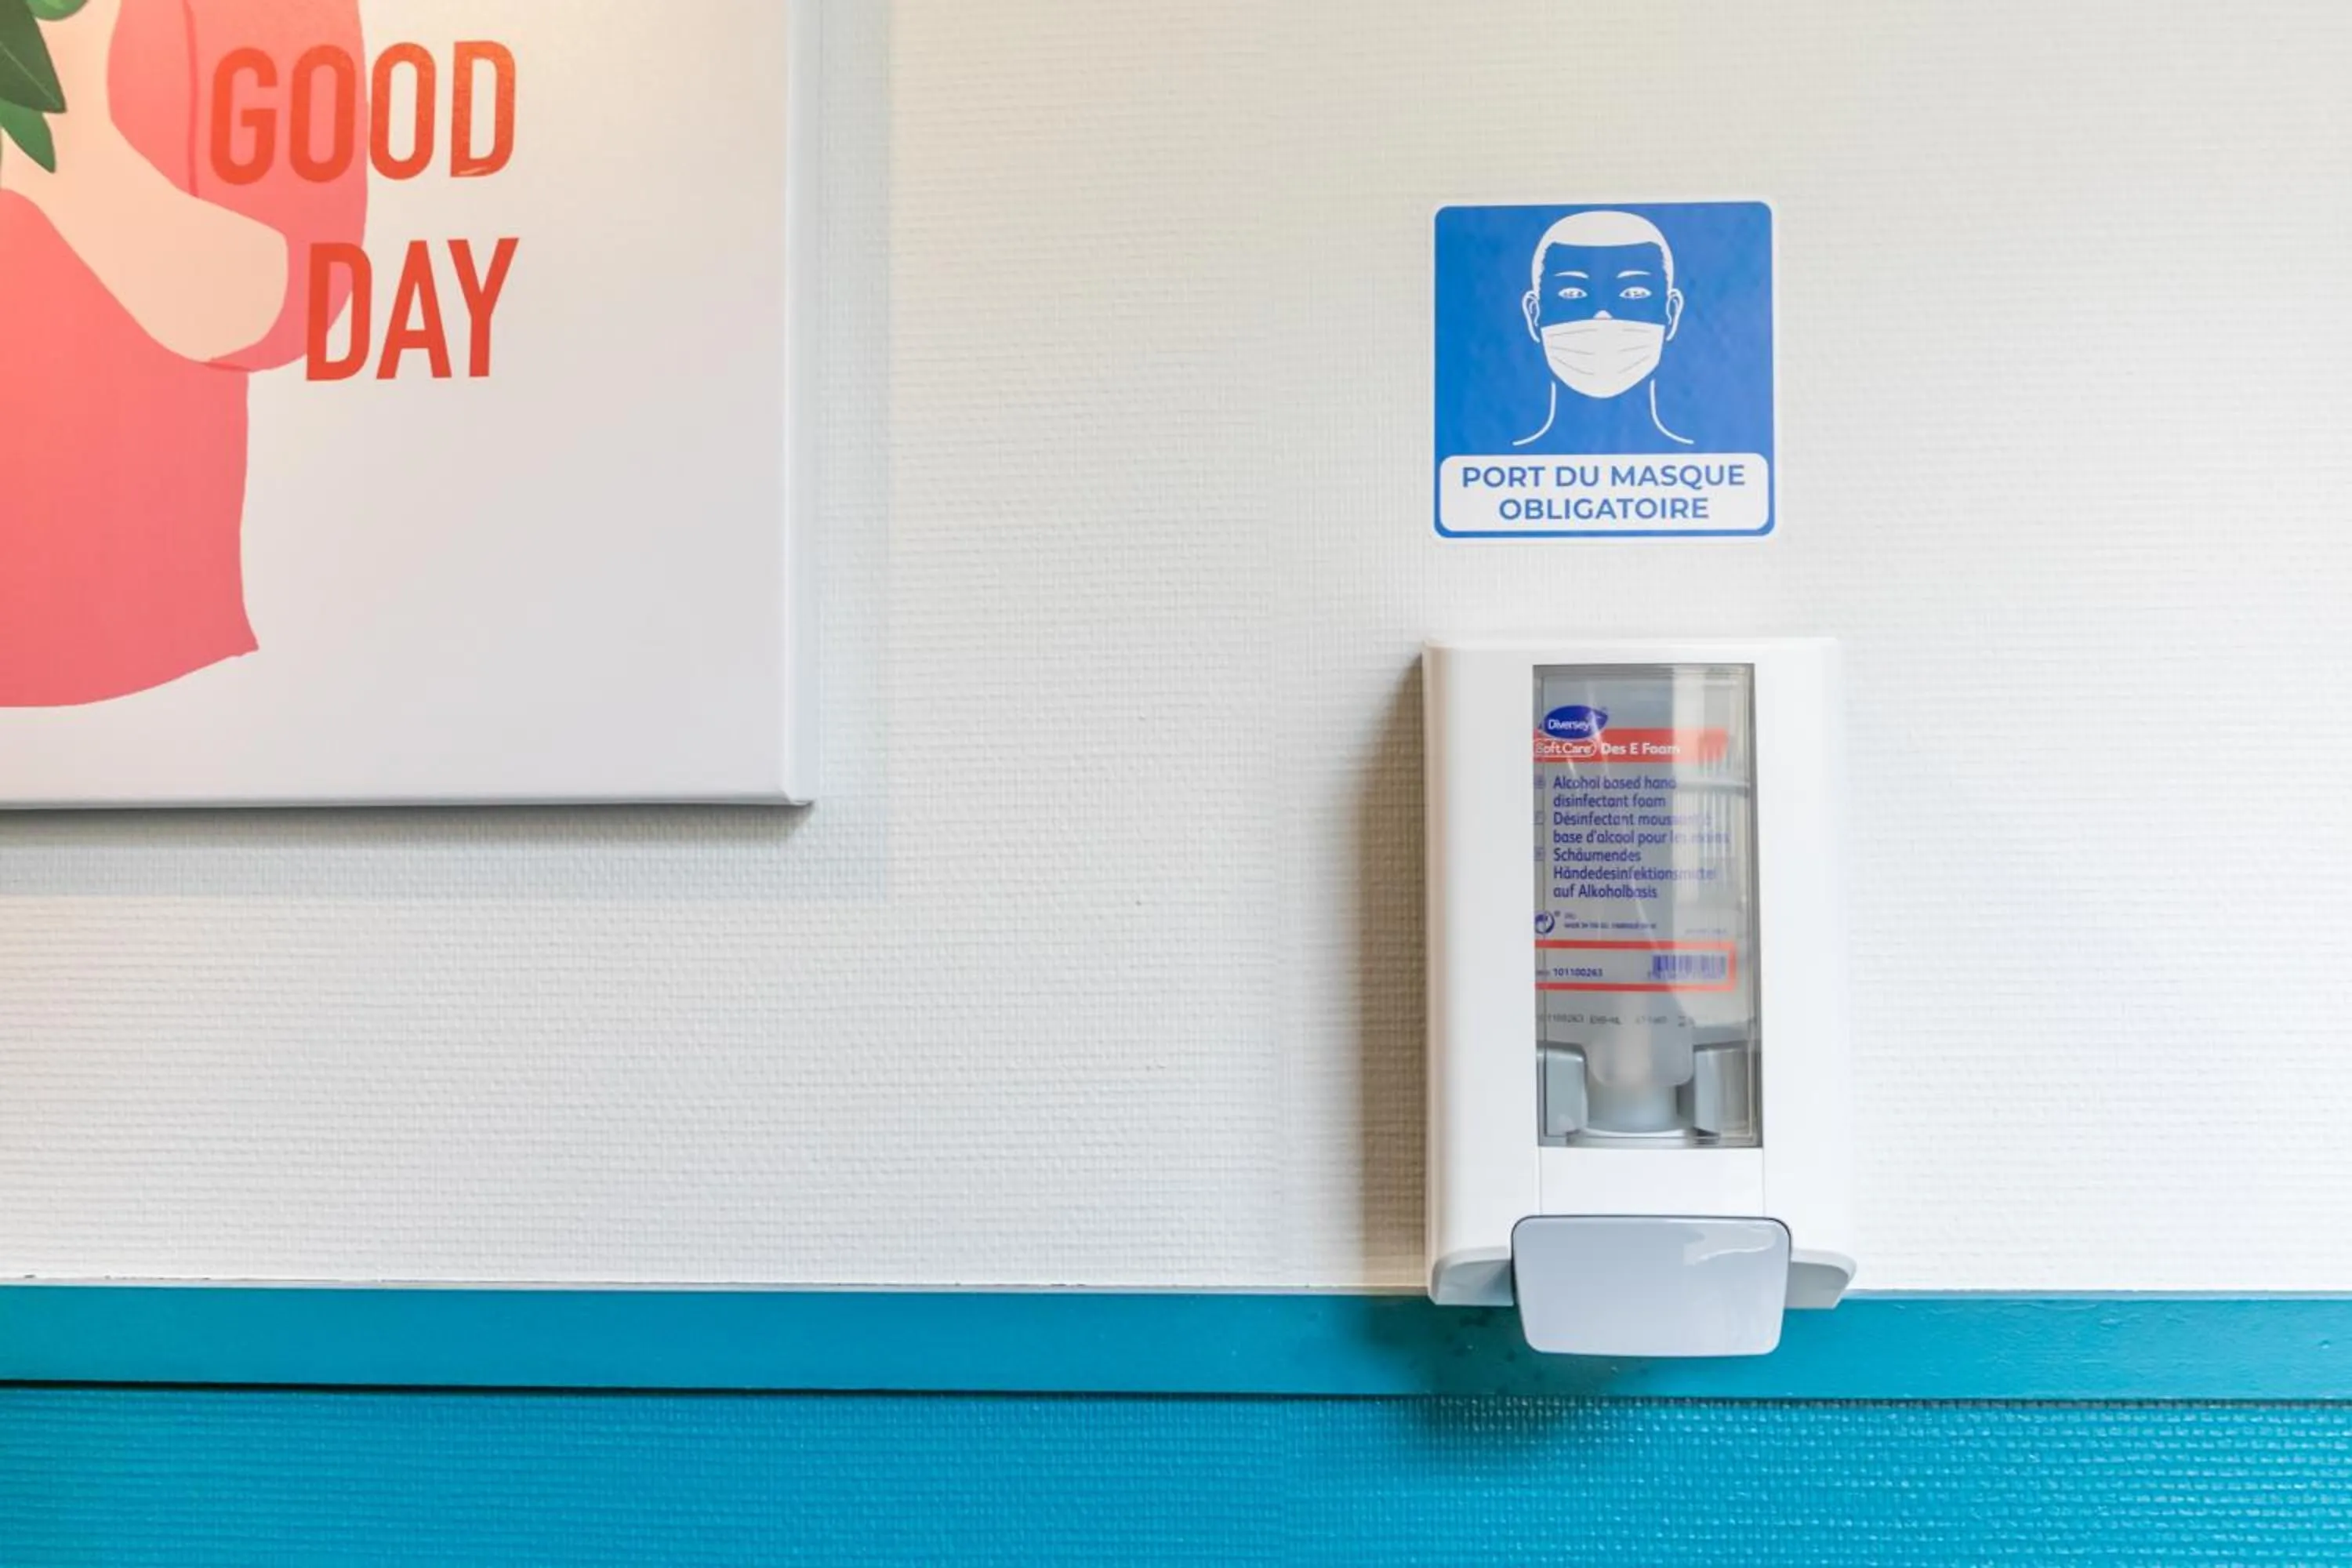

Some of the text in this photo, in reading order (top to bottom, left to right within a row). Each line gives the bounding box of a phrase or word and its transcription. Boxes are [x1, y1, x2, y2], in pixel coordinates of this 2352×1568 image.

[210, 41, 516, 185] GOOD
[307, 238, 519, 381] DAY
[1462, 464, 1745, 490] PORT DU MASQUE
[1499, 497, 1709, 520] OBLIGATOIRE
[1548, 718, 1591, 731] Diversey
[1601, 742, 1626, 754] Des
[1630, 742, 1639, 754] E
[1642, 742, 1680, 754] Foam
[1552, 775, 1600, 789] Alcohol
[1603, 776, 1641, 789] based
[1553, 793, 1666, 808] disinfectant foam
[1553, 811, 1634, 826] Désinfectant
[1553, 829, 1583, 844] base
[1586, 829, 1635, 844] d'alcool
[1638, 833, 1668, 847] pour
[1553, 847, 1641, 862] Schäumendes
[1553, 884, 1657, 898] auf Alkoholbasis
